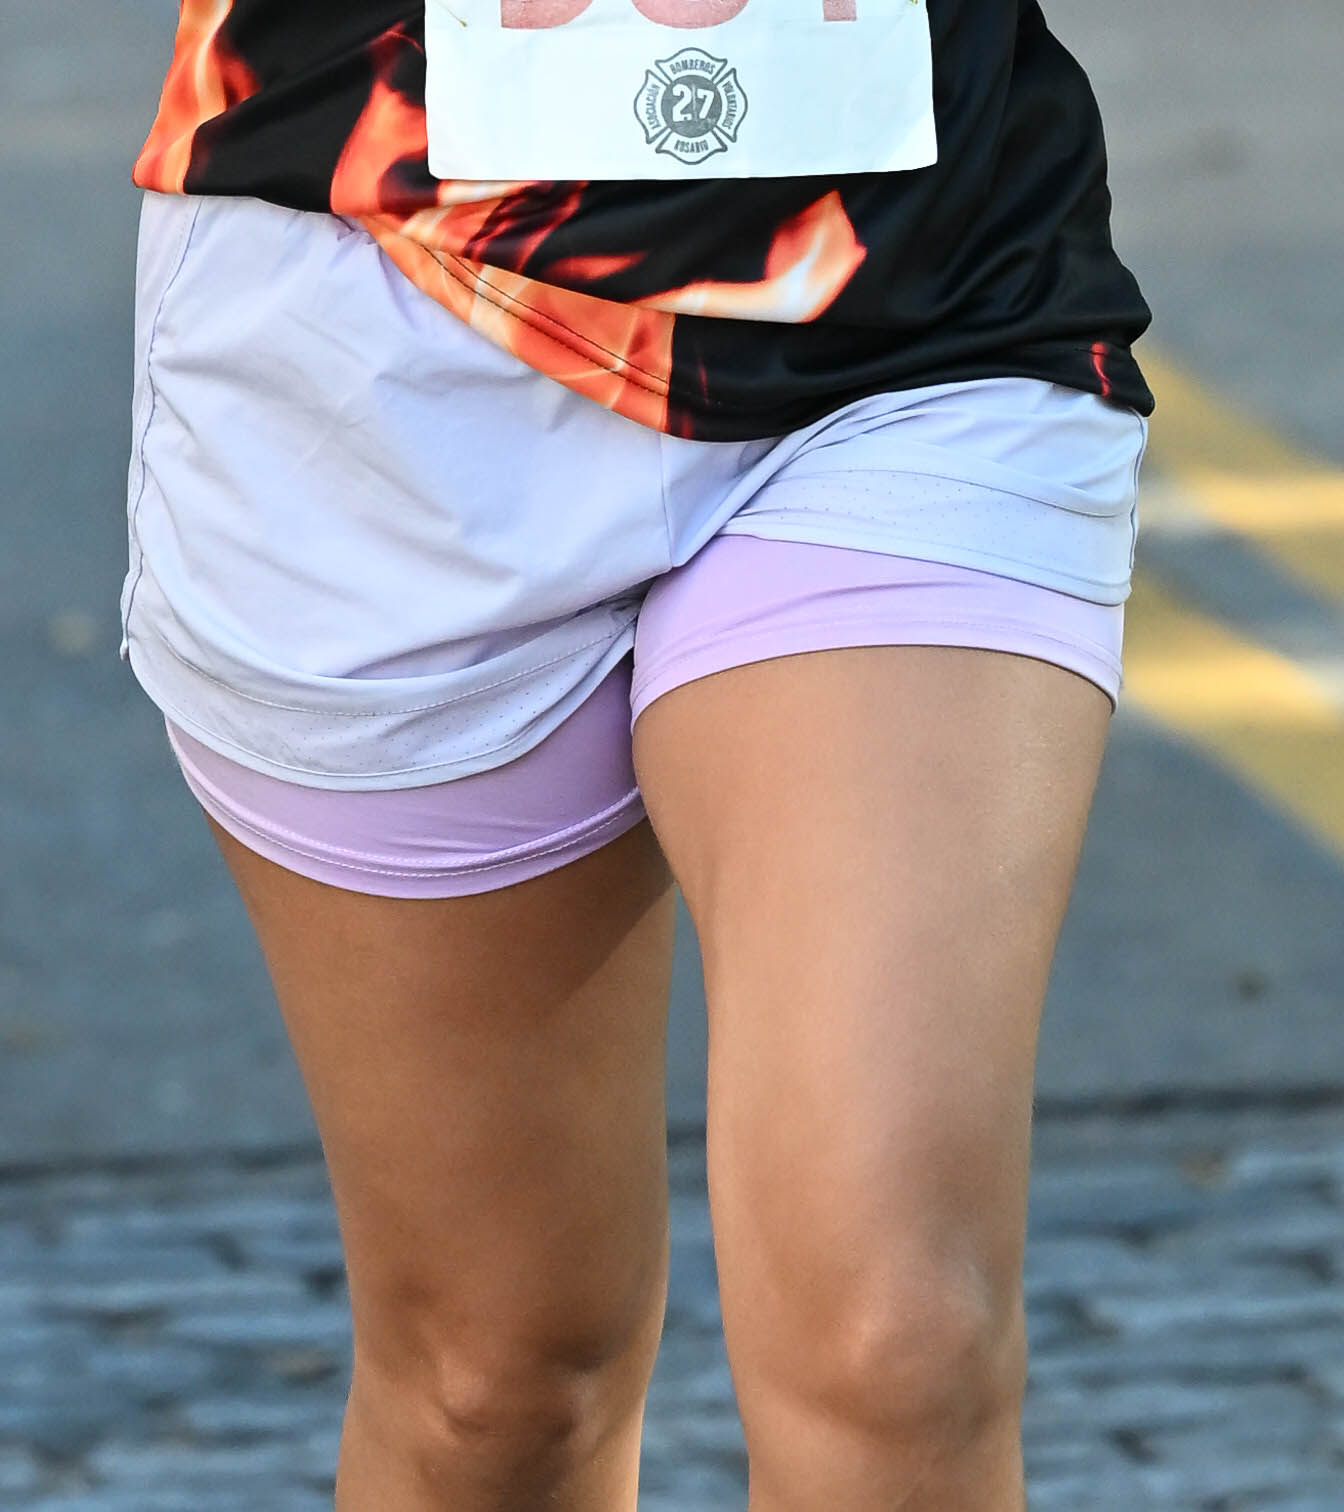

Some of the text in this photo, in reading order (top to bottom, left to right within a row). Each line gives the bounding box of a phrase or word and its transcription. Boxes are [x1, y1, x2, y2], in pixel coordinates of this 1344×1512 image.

[670, 59, 716, 75] BOMBEROS
[672, 83, 715, 123] 27
[674, 140, 709, 153] ROSARIO
